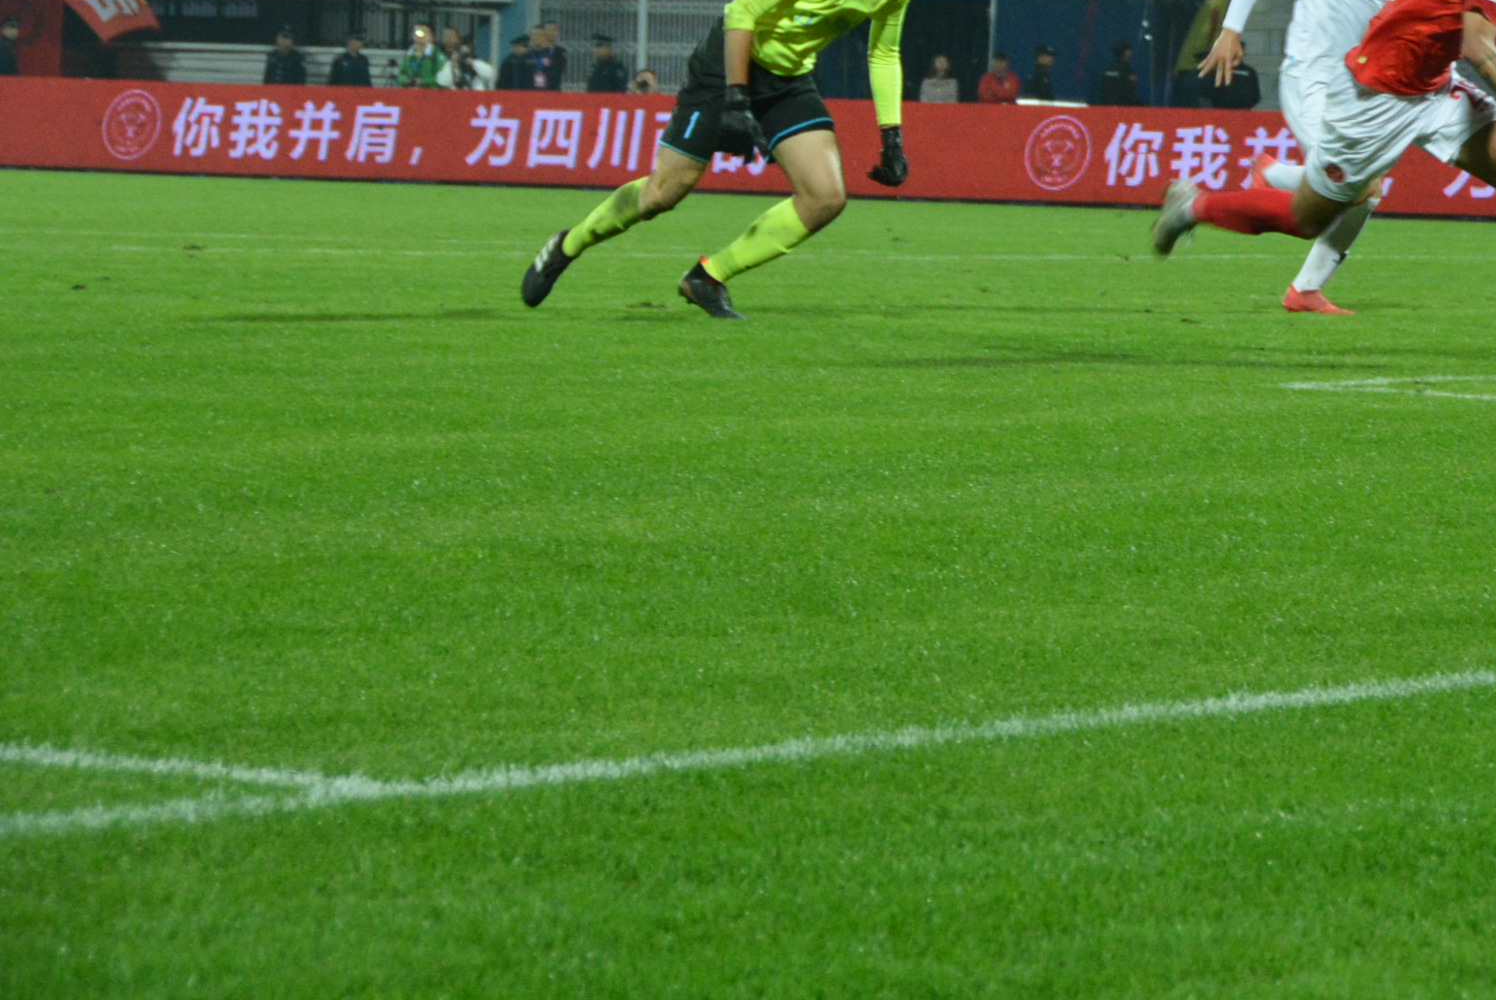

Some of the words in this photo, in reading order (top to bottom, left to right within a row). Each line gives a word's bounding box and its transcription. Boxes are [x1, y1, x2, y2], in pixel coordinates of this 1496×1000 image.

[172, 96, 423, 166] 你我并肩，
[683, 111, 701, 139] 1
